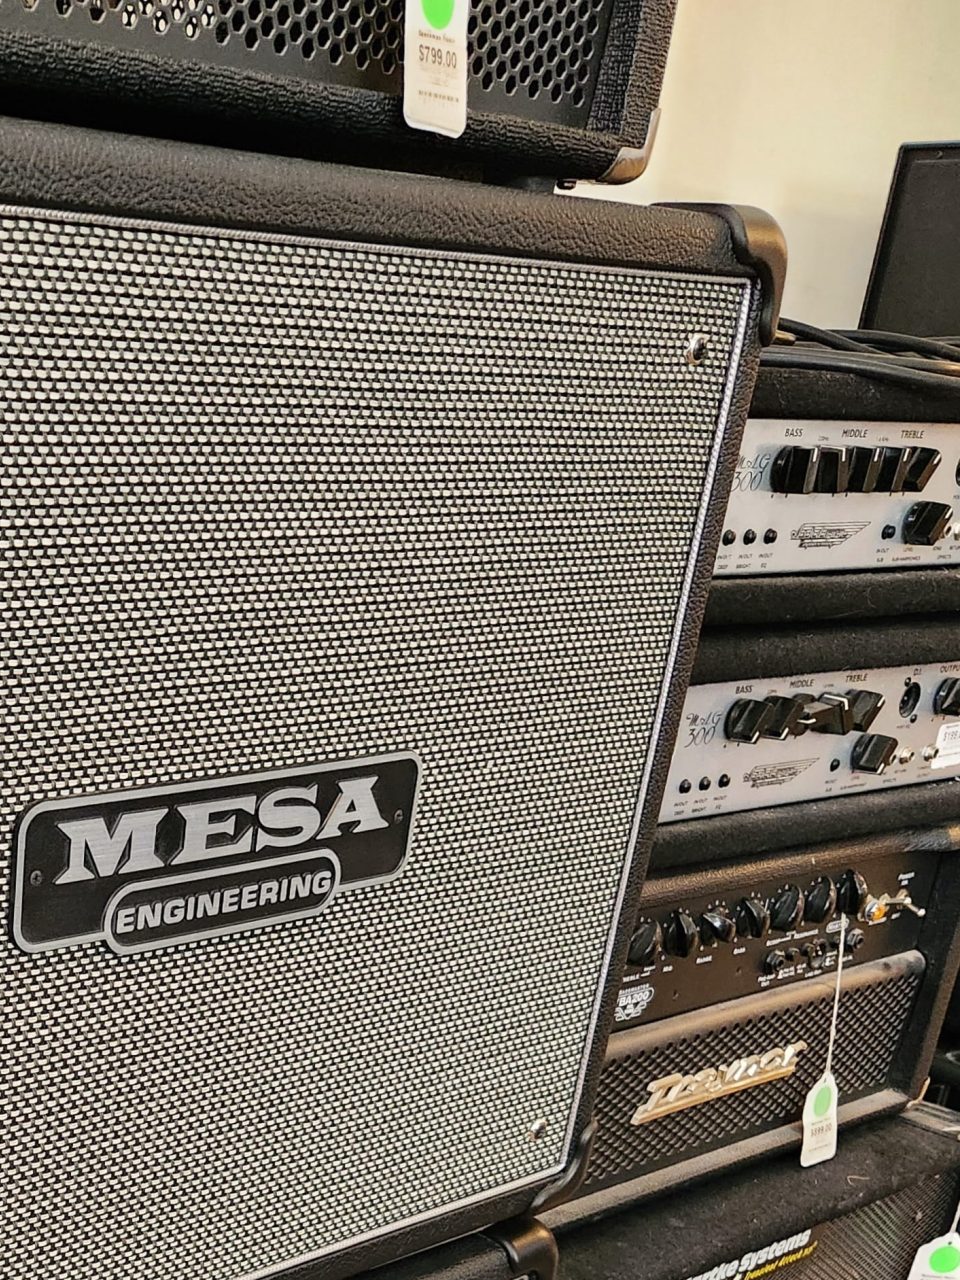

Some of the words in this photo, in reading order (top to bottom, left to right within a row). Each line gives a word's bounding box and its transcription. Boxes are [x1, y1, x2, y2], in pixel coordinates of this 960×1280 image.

[418, 43, 458, 69] $799.00
[784, 428, 804, 438] BASS
[842, 428, 869, 439] MIDDLE
[900, 429, 925, 440] TREBLE
[731, 471, 763, 492] 300
[940, 664, 960, 674] OUTPU
[789, 679, 815, 688] MIDDLE
[845, 673, 868, 683] TREBLE
[735, 685, 754, 695] BASS
[684, 726, 716, 748] 300
[54, 775, 390, 886] MESA
[115, 869, 333, 935] ENGINEERING
[631, 1040, 808, 1125] Traynor
[738, 1228, 812, 1272] Systems
